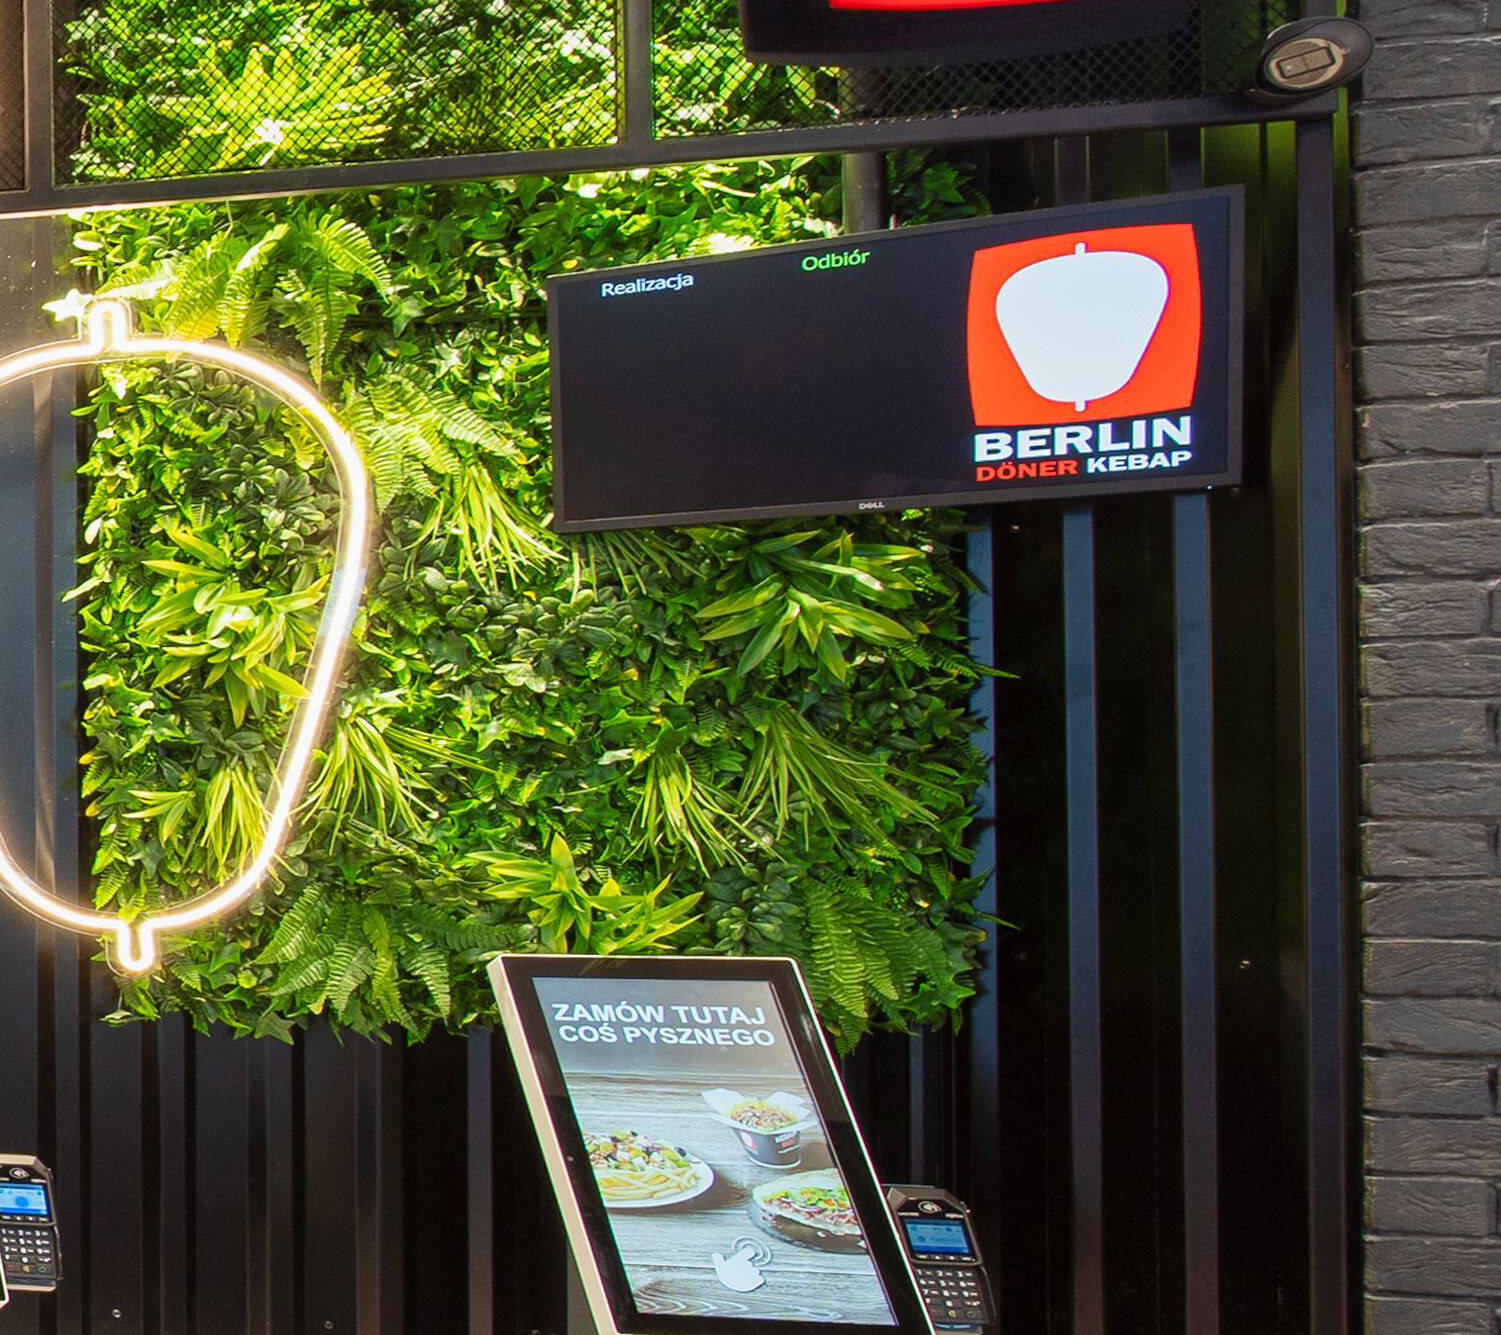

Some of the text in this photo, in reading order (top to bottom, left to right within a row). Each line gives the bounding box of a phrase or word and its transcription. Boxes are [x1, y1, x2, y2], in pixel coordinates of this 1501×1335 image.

[801, 248, 870, 271] Odbiór
[601, 273, 694, 297] Realizacja
[974, 416, 1192, 463] BERLIN
[976, 450, 1193, 483] DÖNER KEBAP
[552, 1001, 767, 1025] ZAMÓW TUTAJ
[559, 1023, 776, 1046] COŚ PYSZNEGO
